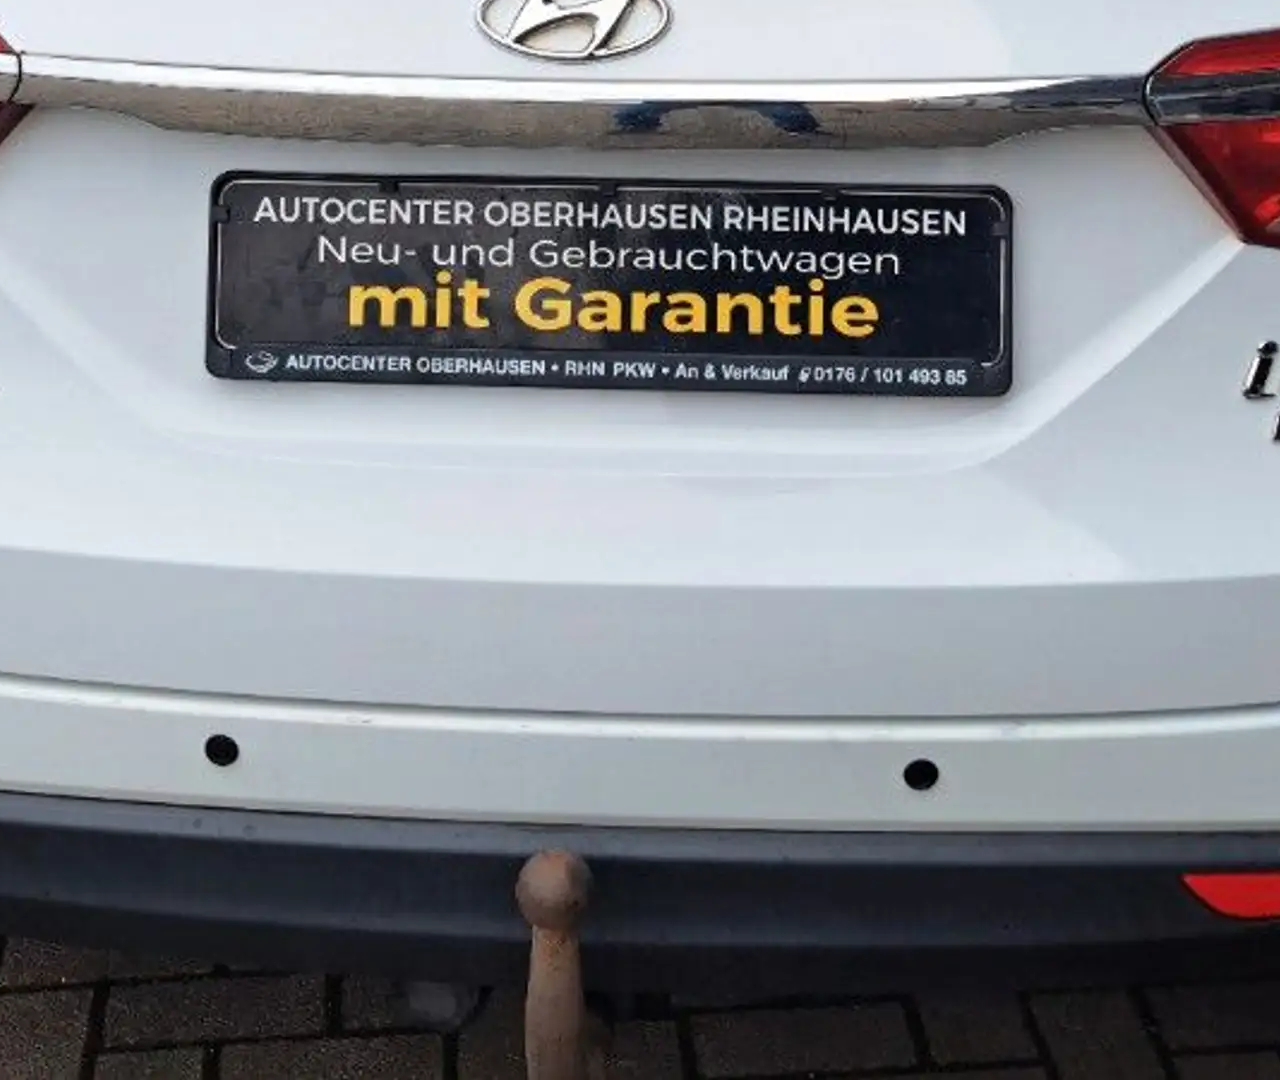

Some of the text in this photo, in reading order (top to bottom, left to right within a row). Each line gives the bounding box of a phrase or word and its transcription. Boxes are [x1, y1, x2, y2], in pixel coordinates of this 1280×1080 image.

[252, 196, 967, 236] AUTOCENTER OBERHAUSEN RHEINHAUSEN
[318, 235, 900, 279] Neu- und Gebrauchtwagen
[348, 270, 880, 338] mit Garantie
[285, 353, 411, 371] AUTOCENTER
[417, 357, 546, 376] OBERHAUSEN
[565, 361, 605, 376] RHN
[613, 362, 656, 379] PKW
[675, 363, 699, 379] An
[703, 363, 716, 379] &
[722, 363, 789, 382] Verkauf
[814, 367, 855, 382] 0176
[874, 367, 903, 383] 101
[909, 368, 940, 384] 493
[945, 369, 967, 385] 85
